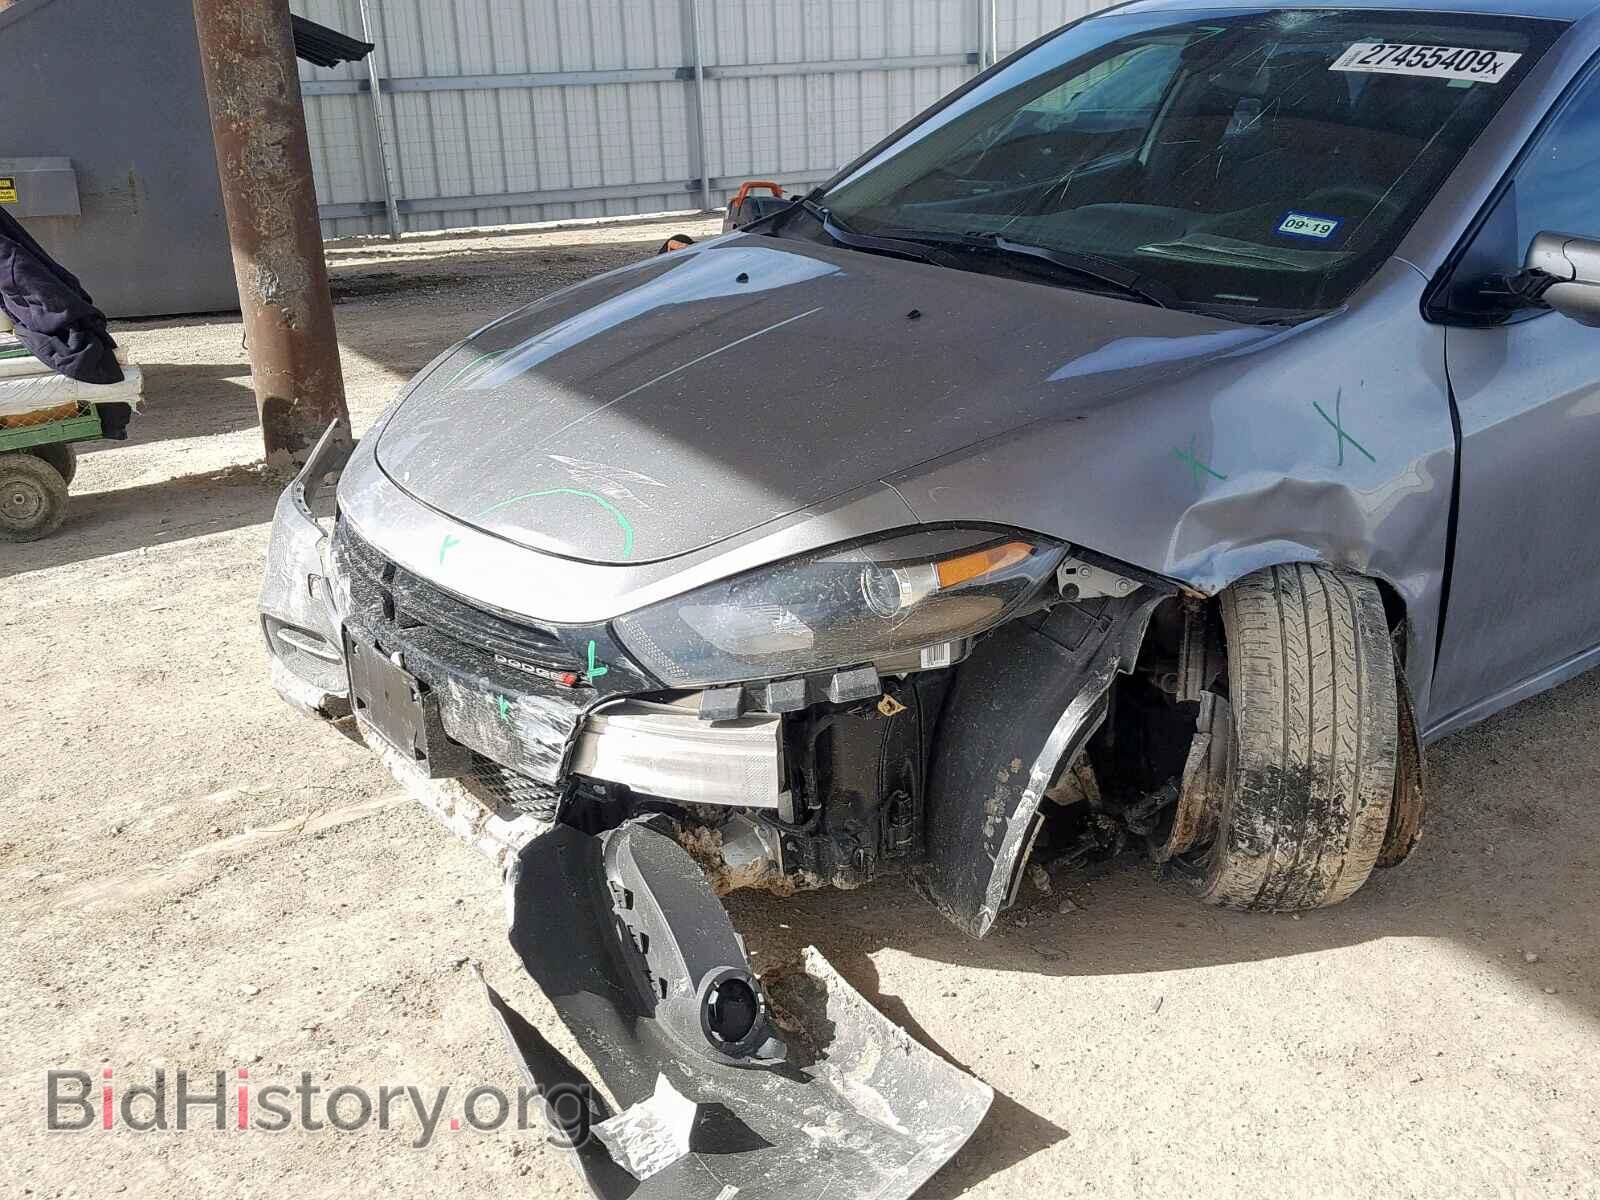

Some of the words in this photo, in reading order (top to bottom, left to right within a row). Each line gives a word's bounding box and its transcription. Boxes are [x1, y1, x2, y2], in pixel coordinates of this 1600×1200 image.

[1285, 219, 1305, 230] 09
[1312, 223, 1331, 234] 19
[493, 653, 562, 683] DODGE
